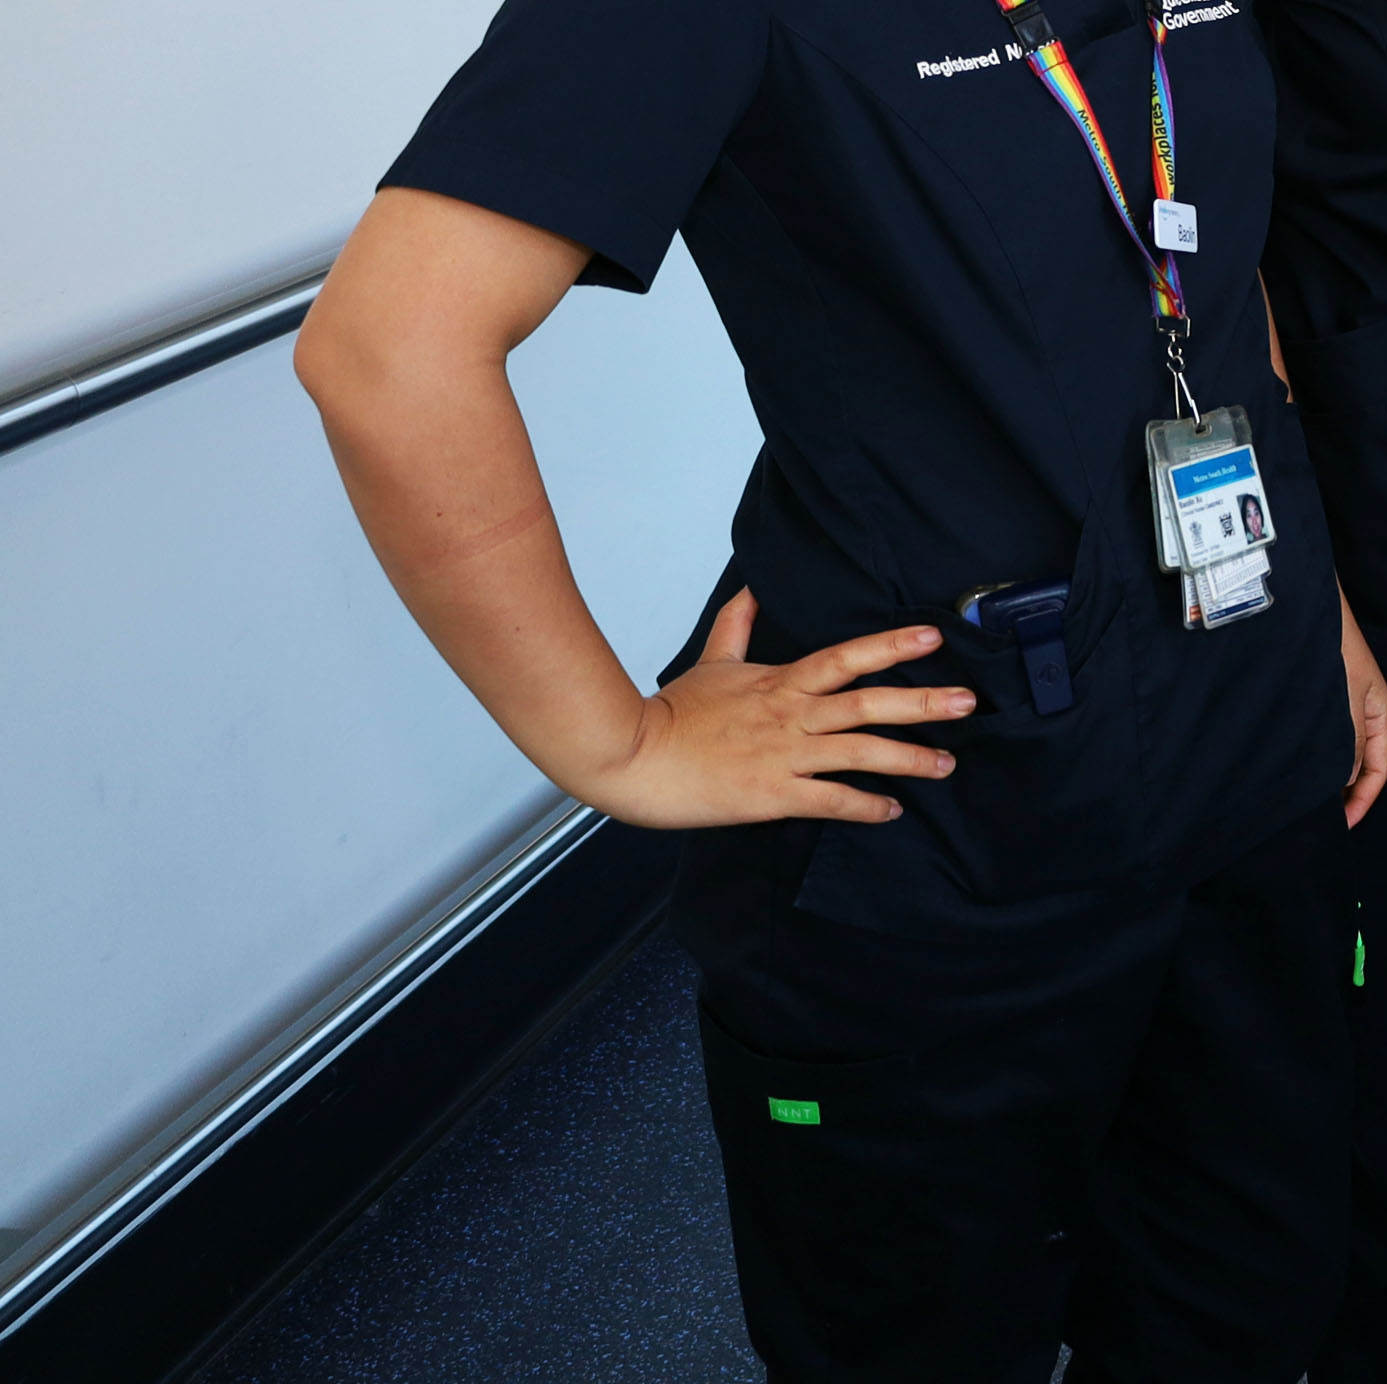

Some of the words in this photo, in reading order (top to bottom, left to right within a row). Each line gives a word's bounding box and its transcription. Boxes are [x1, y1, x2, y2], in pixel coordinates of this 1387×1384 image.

[1162, 0, 1240, 31] Government
[916, 48, 1001, 79] Registered
[1078, 109, 1101, 152] Metro
[1153, 102, 1175, 186] workplaces
[777, 1107, 812, 1121] NNT
